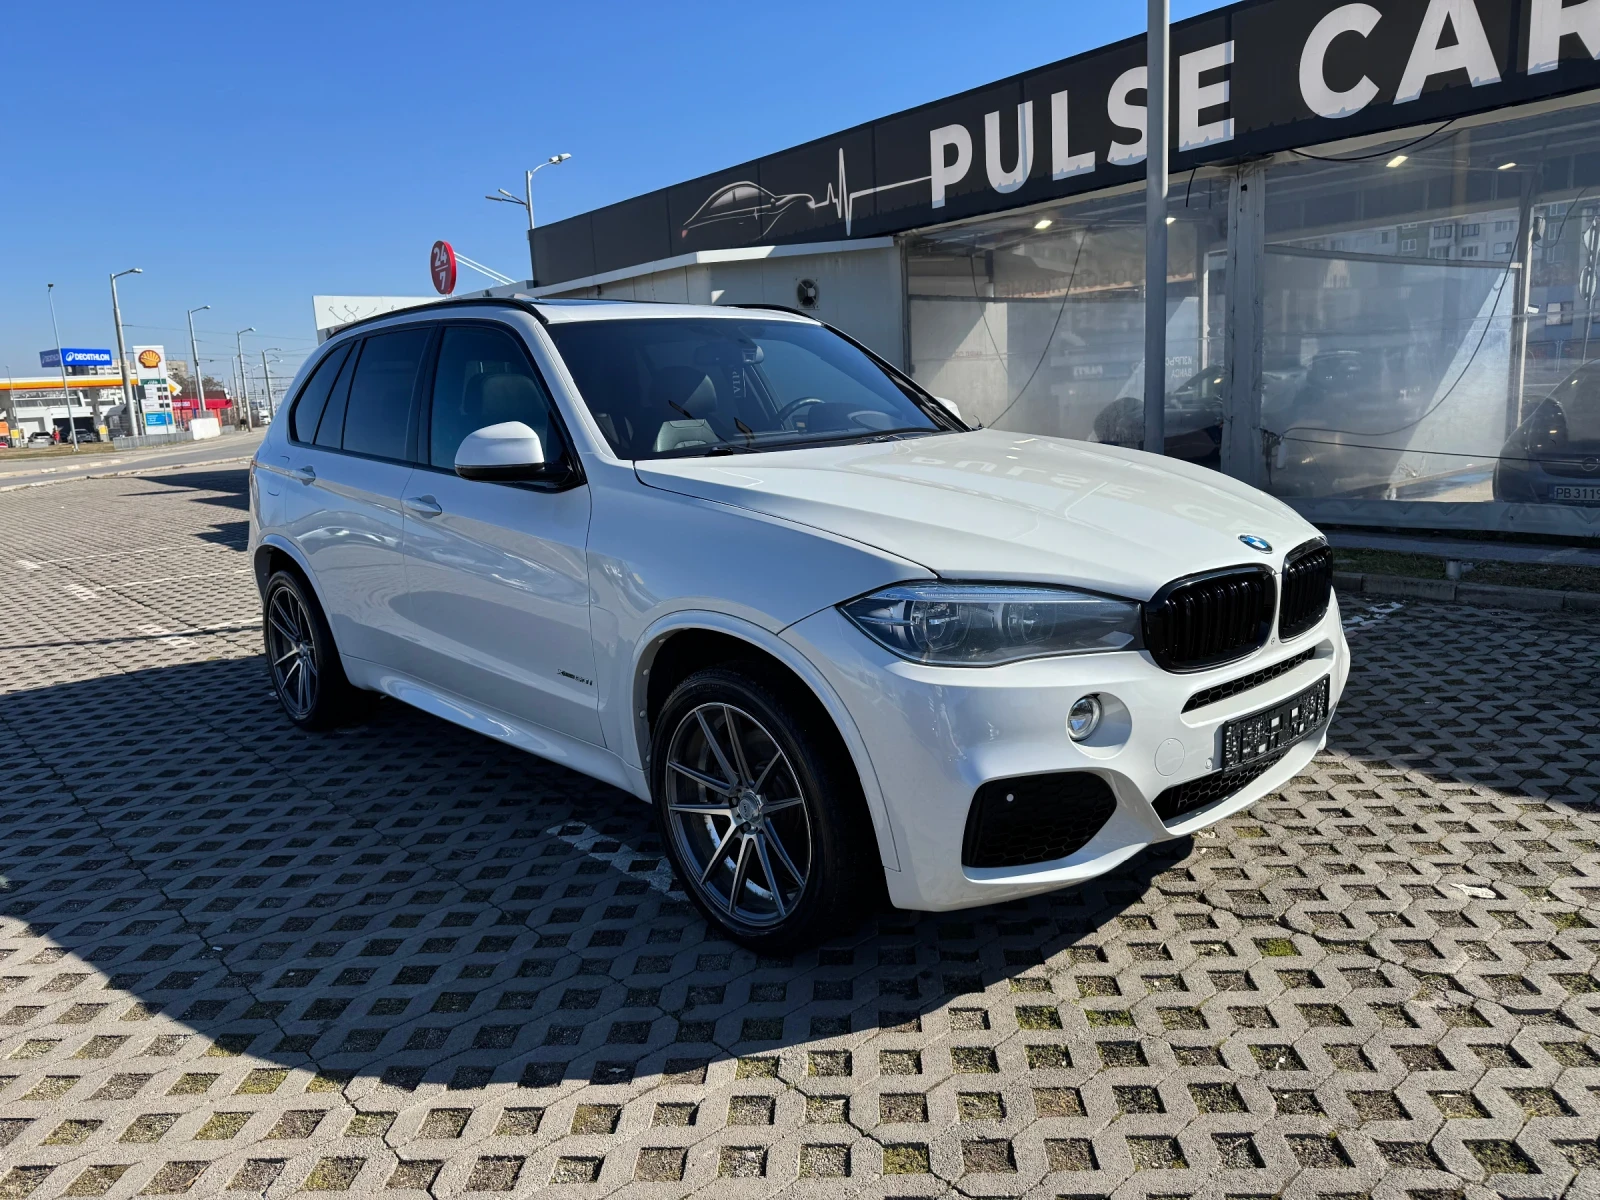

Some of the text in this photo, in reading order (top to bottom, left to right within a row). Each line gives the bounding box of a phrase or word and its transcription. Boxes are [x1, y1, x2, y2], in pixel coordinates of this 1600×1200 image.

[929, 39, 1235, 210] PULSE
[434, 245, 448, 266] 24
[440, 271, 446, 290] 7
[74, 352, 110, 361] DECATHLON
[732, 371, 740, 394] VIP
[1556, 488, 1571, 498] PB
